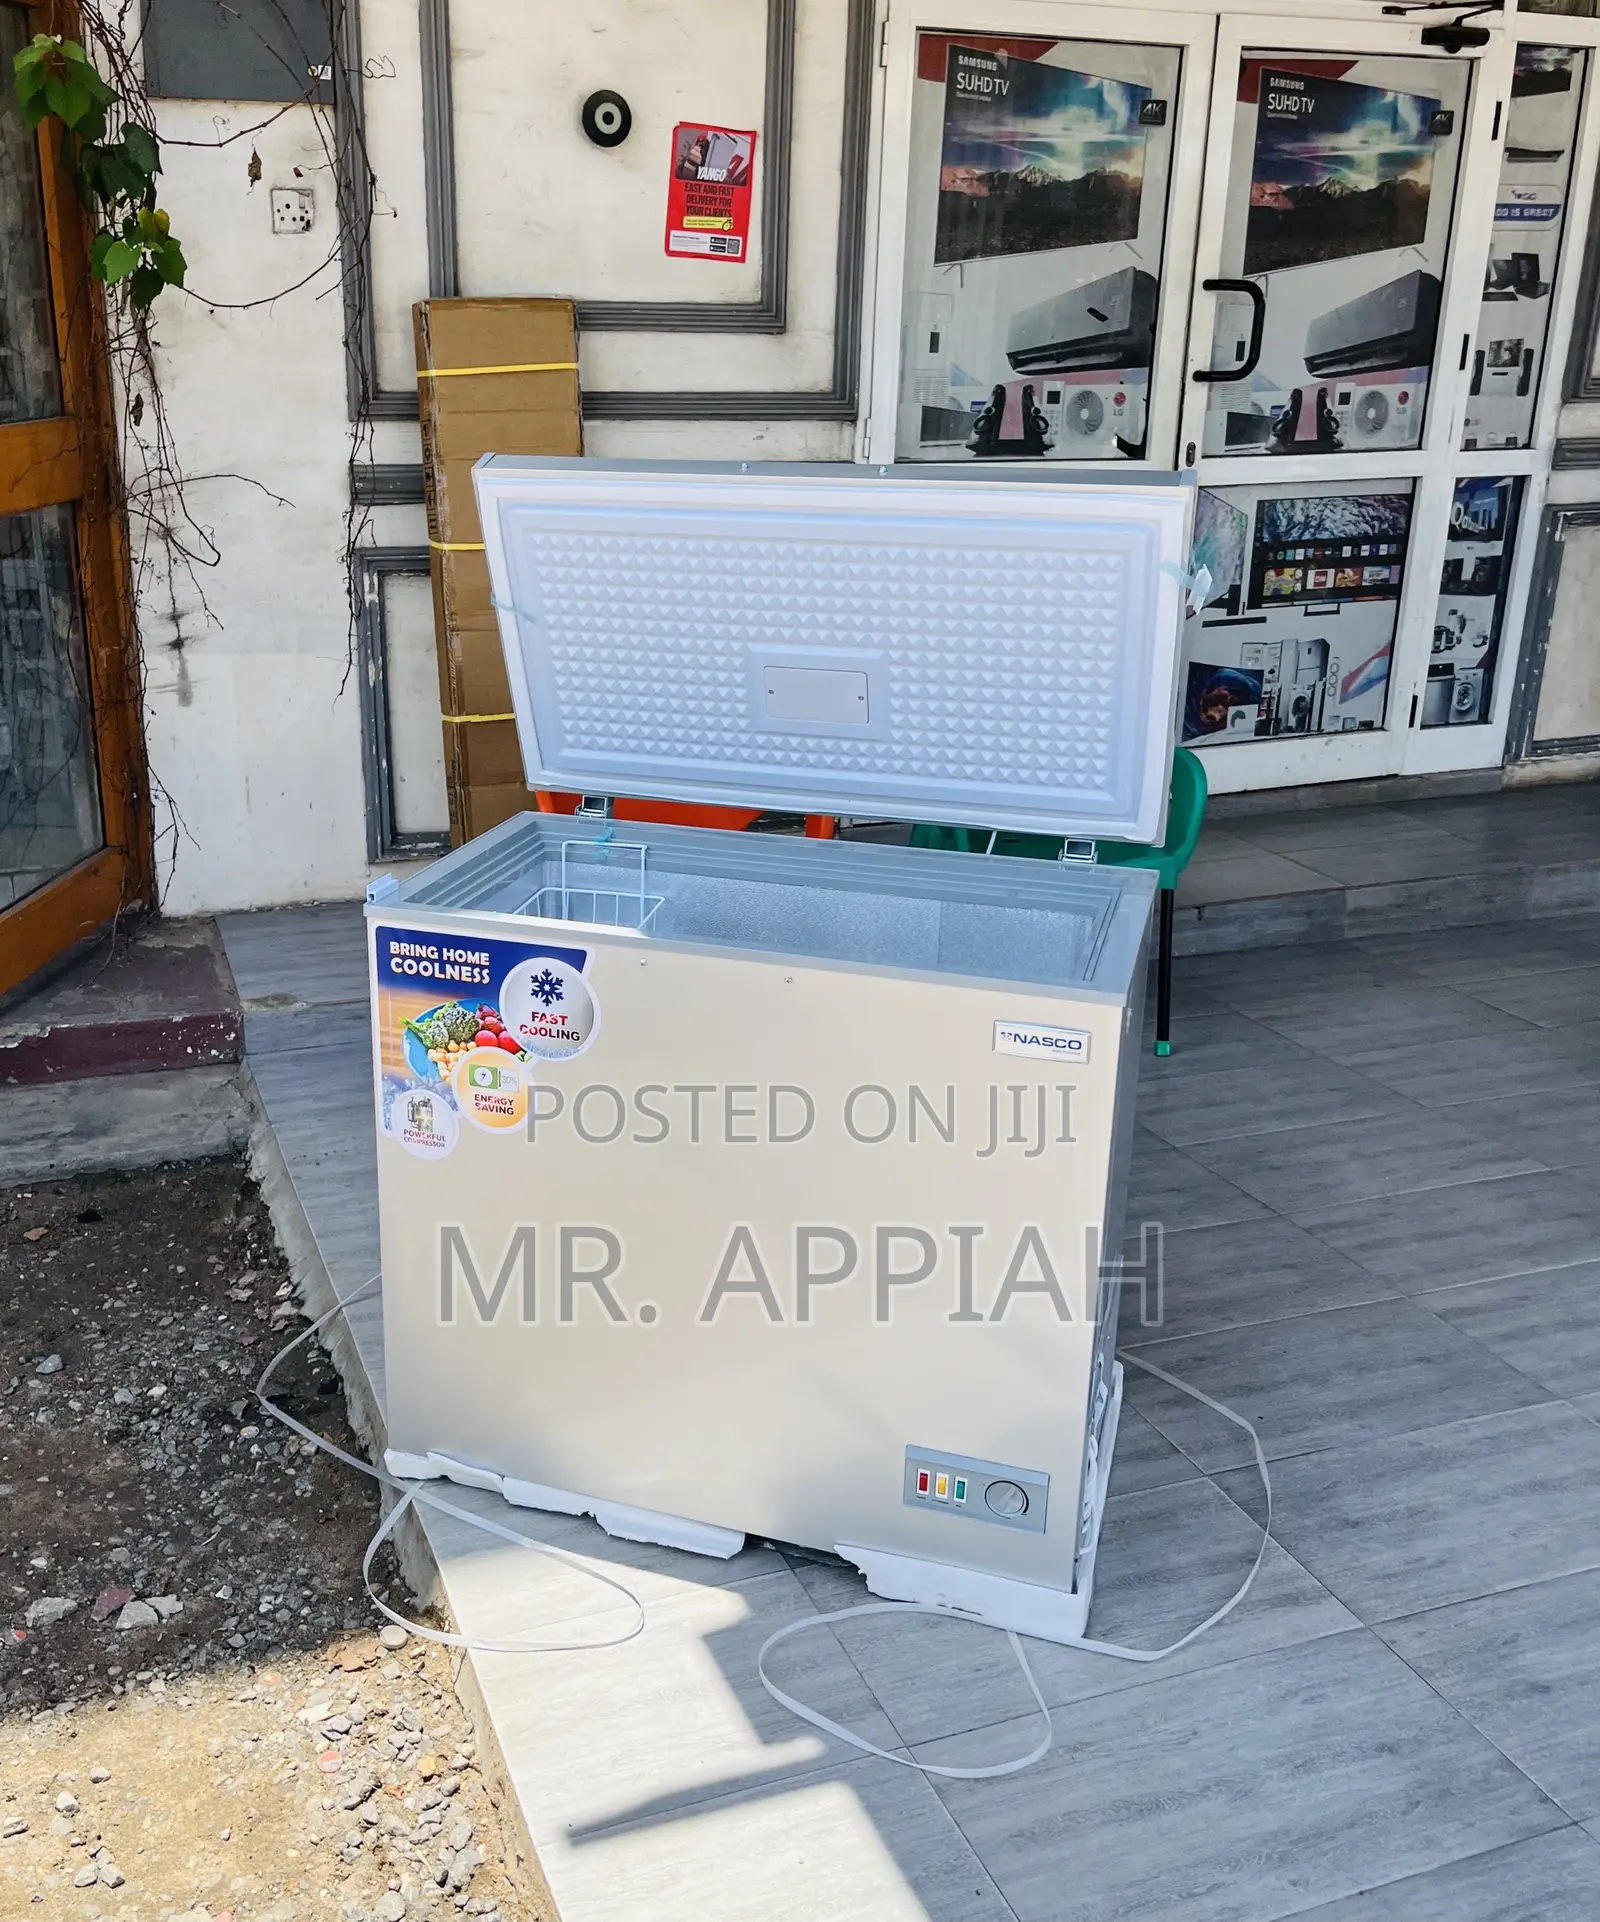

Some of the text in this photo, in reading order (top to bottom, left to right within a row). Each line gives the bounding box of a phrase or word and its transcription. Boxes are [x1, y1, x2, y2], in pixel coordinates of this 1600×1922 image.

[957, 54, 998, 71] SAMSUNG
[956, 72, 1010, 96] SUHD TV
[1269, 77, 1305, 91] SAMSUNG
[1267, 93, 1316, 113] SUHD TV
[697, 166, 727, 182] YANGO
[703, 184, 718, 195] AND
[719, 187, 734, 197] FAST
[687, 194, 732, 208] DELIVERY FOR
[686, 205, 731, 217] YOUR CLIENTS
[389, 941, 490, 966] BRING HOME
[390, 957, 490, 985] COOLNESS
[531, 1011, 568, 1026] FAST
[519, 1023, 581, 1042] COOLING
[1013, 1033, 1082, 1050] NASCO
[501, 1074, 518, 1087] 30%
[474, 1093, 514, 1107] ENERGY
[474, 1101, 515, 1116] SAVING
[403, 1128, 447, 1143] POWERFUL
